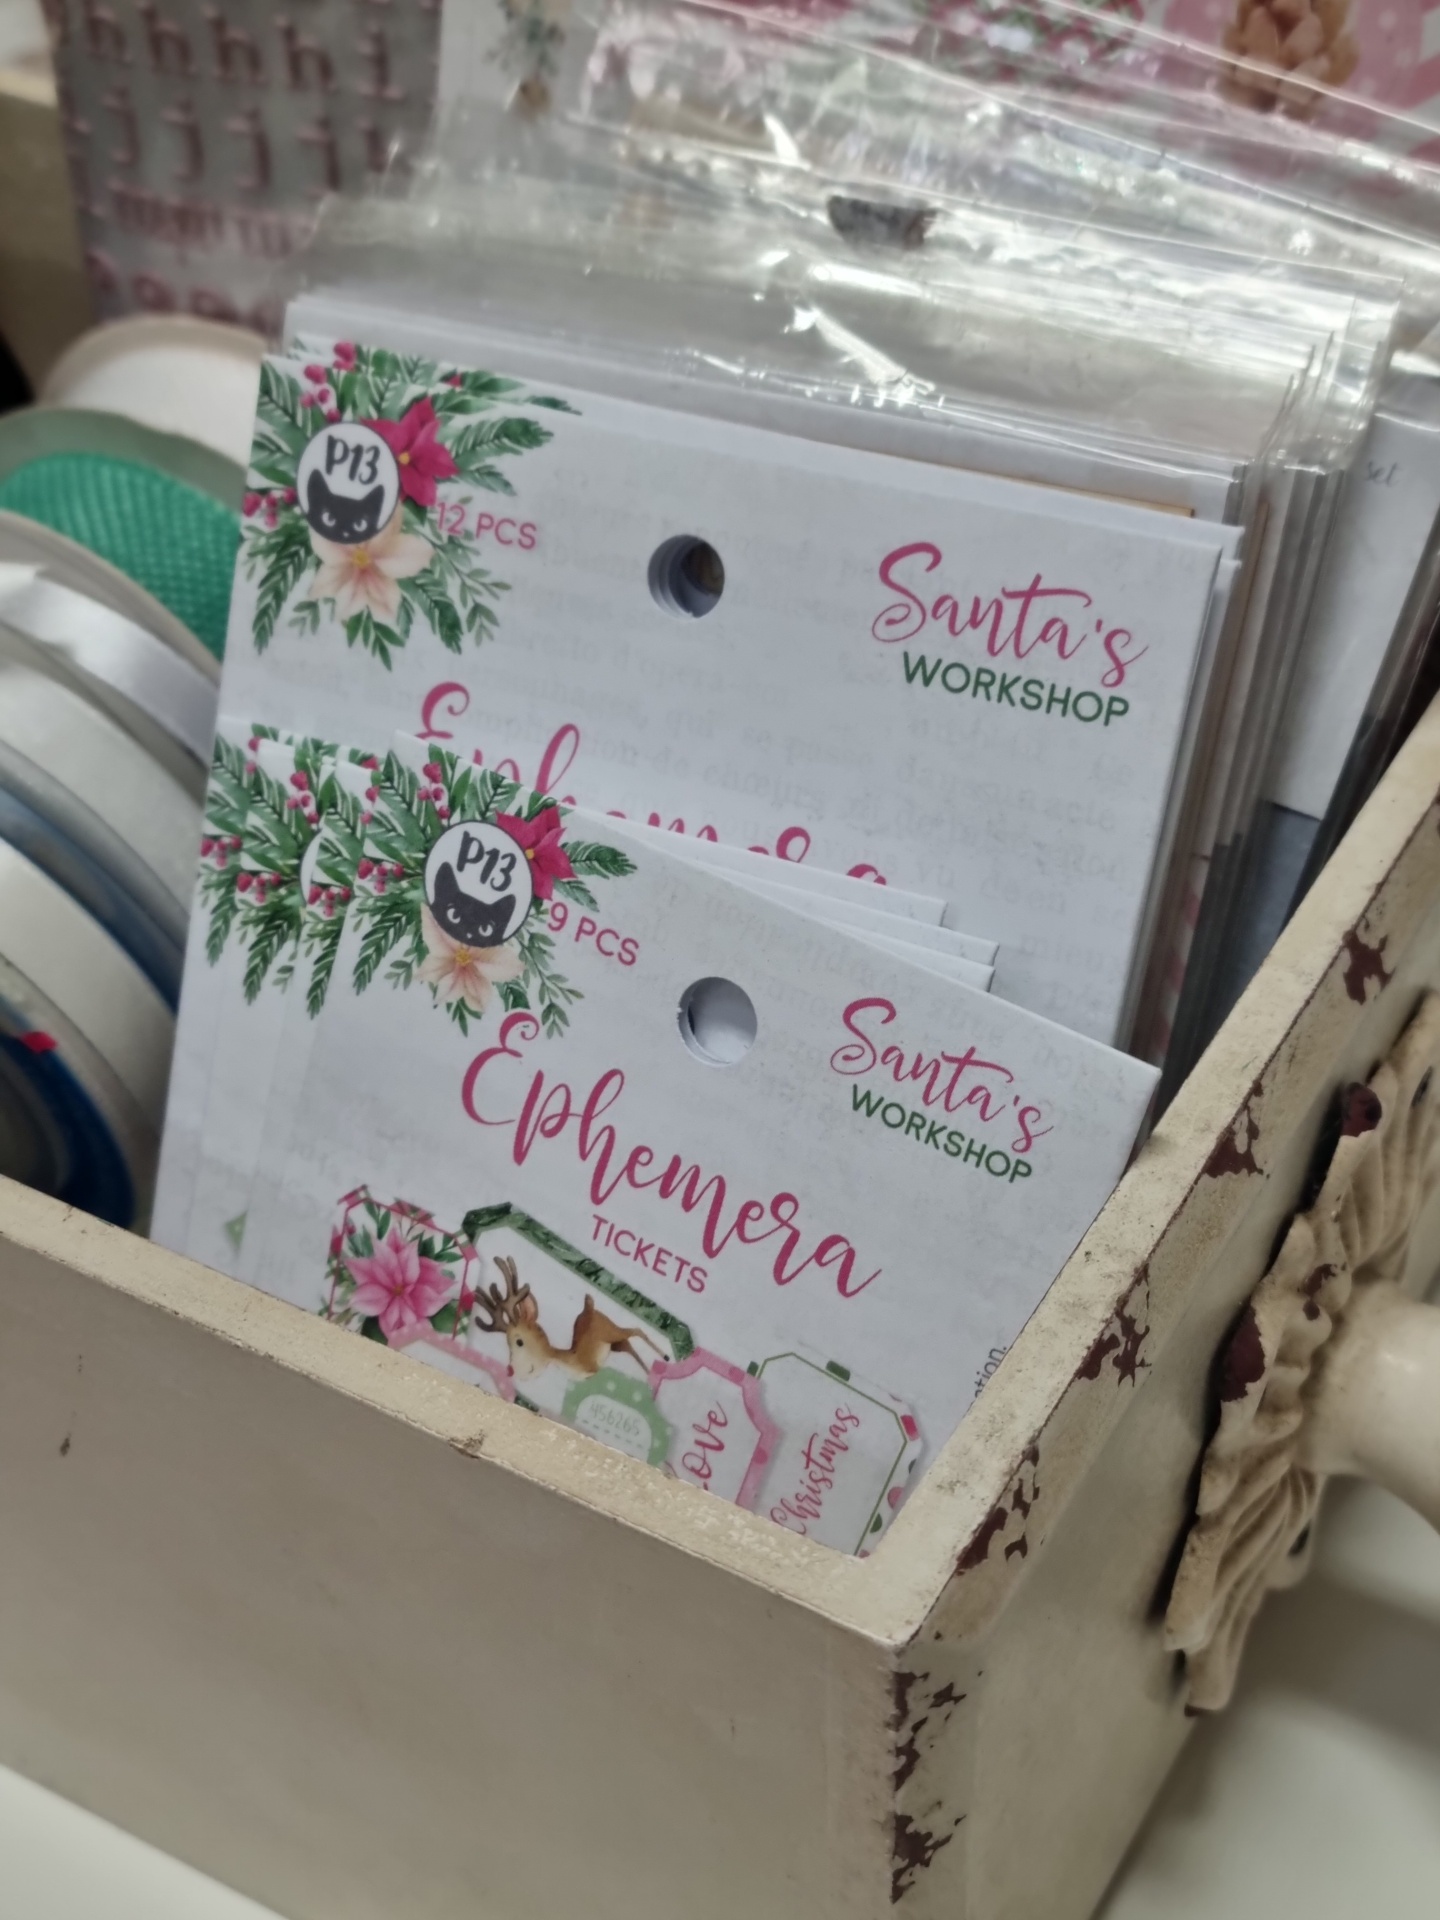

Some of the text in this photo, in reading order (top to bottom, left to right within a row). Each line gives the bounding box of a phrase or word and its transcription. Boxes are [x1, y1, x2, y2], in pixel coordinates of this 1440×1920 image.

[436, 502, 537, 550] 12 PCS
[872, 541, 1149, 688] Santa's
[902, 651, 1130, 727] WORKSHOP
[548, 902, 640, 966] 9 PCS
[830, 997, 1055, 1153] Santa's
[461, 1011, 882, 1299] Ephemera
[852, 1083, 1033, 1184] WORKSHOP
[591, 1214, 709, 1294] TICKETS
